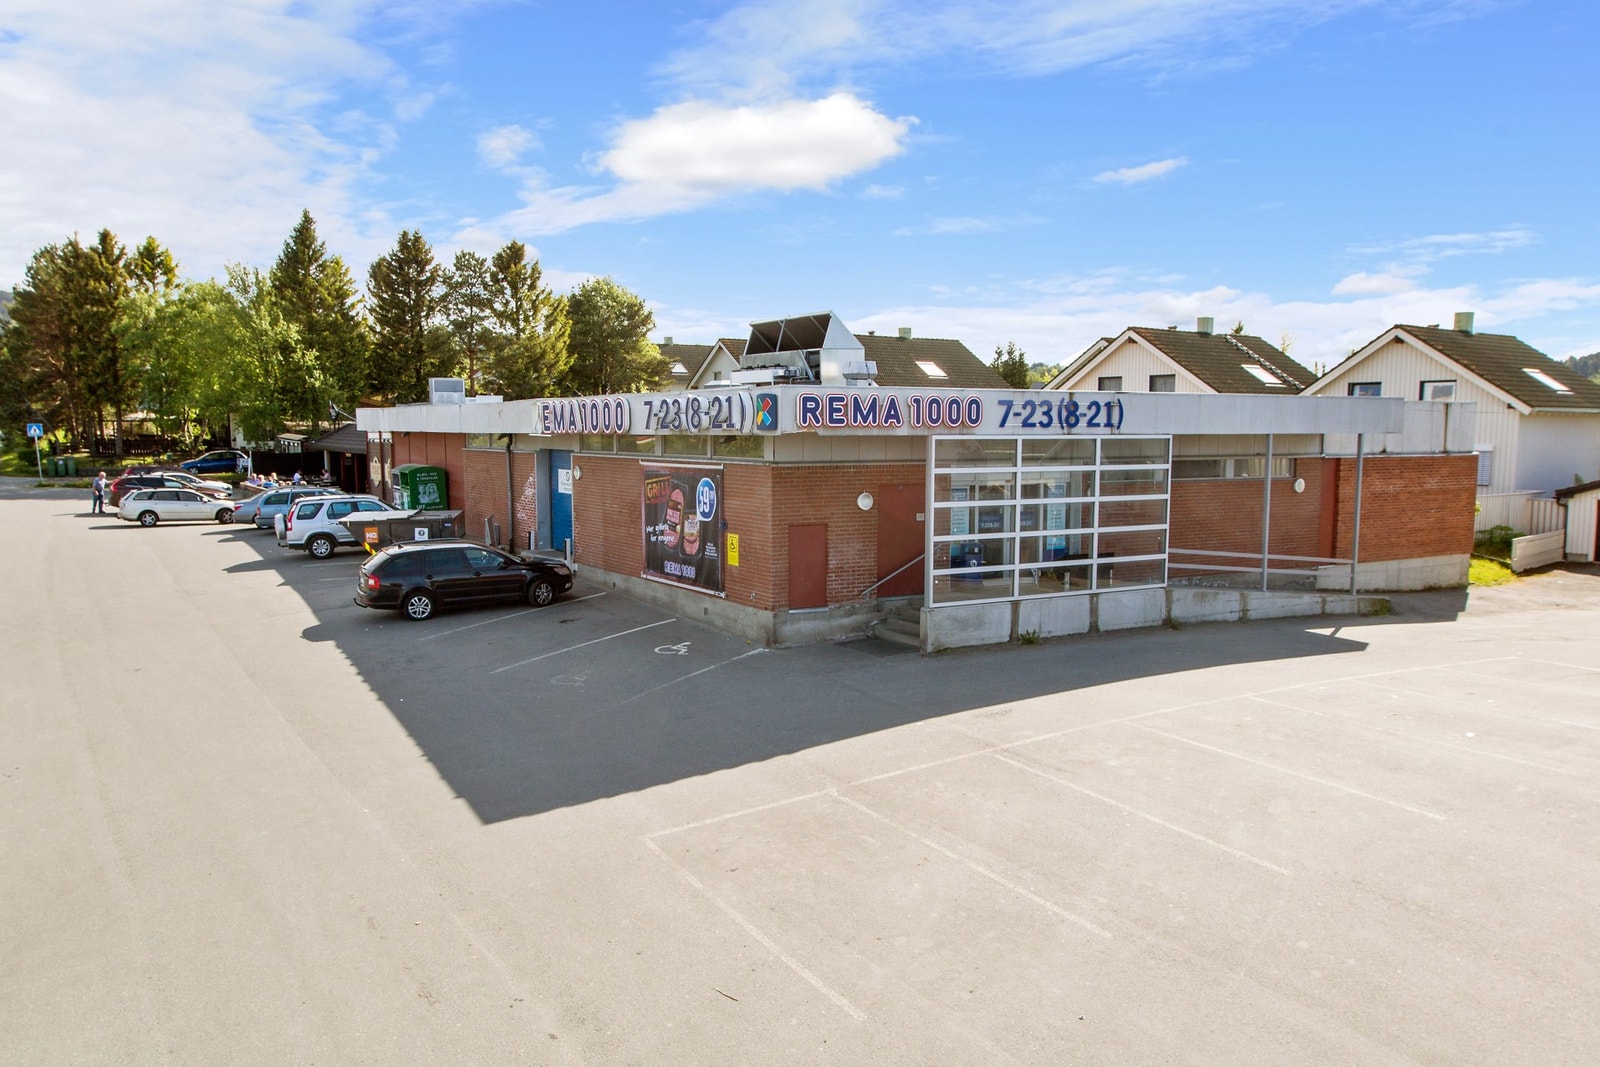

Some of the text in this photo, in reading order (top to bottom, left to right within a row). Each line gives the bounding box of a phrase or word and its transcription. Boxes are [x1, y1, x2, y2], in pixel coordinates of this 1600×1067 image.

[797, 392, 983, 429] REMA 1000
[998, 397, 1124, 430] 7-23(8-21)
[699, 486, 710, 513] 59
